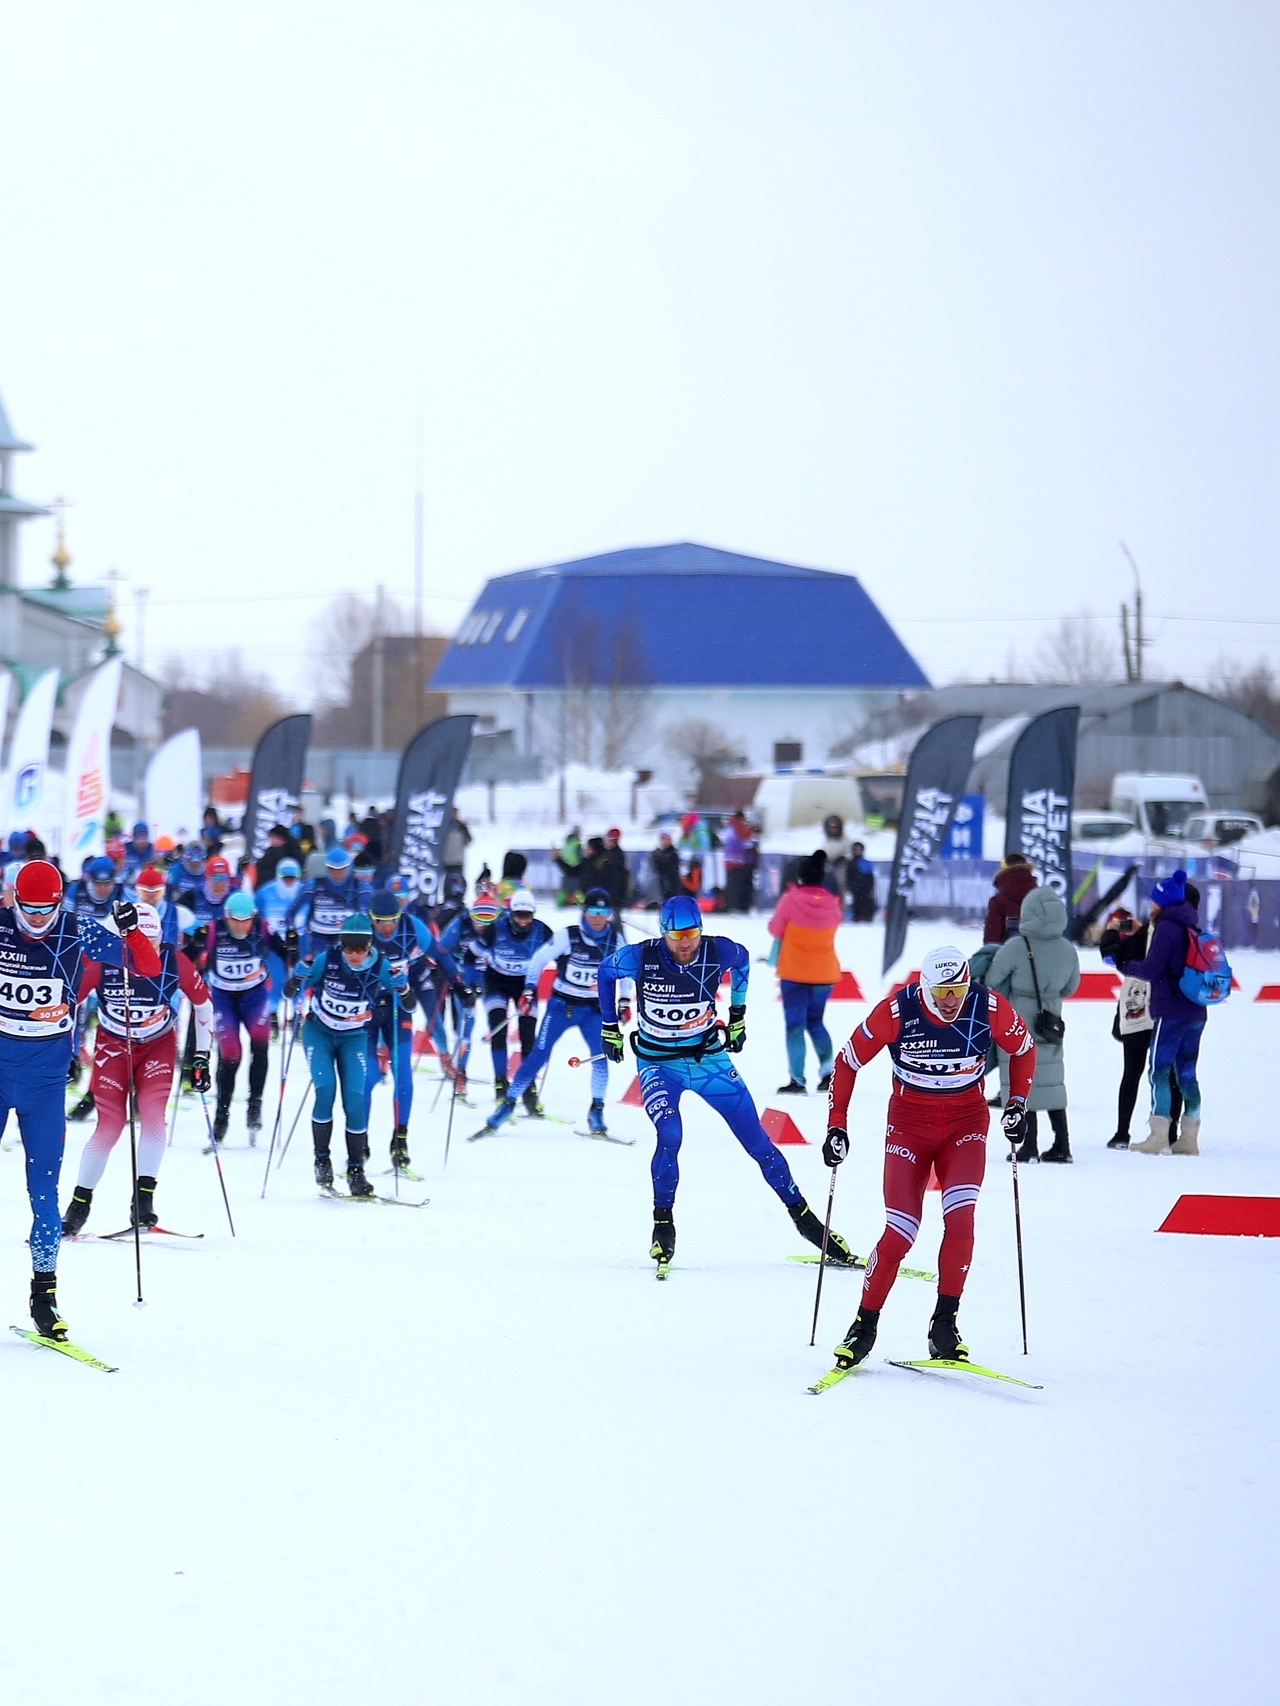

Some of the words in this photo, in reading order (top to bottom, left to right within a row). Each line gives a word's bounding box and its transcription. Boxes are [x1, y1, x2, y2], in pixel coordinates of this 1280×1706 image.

[1045, 788, 1069, 904] OPPET
[224, 963, 254, 975] 410
[935, 961, 959, 969] LUKOIL
[642, 981, 675, 993] XXXIII
[326, 999, 360, 1015] 404
[651, 1008, 701, 1021] 400
[900, 1040, 938, 1050] XXXIII
[886, 1142, 918, 1165] LUKOIL
